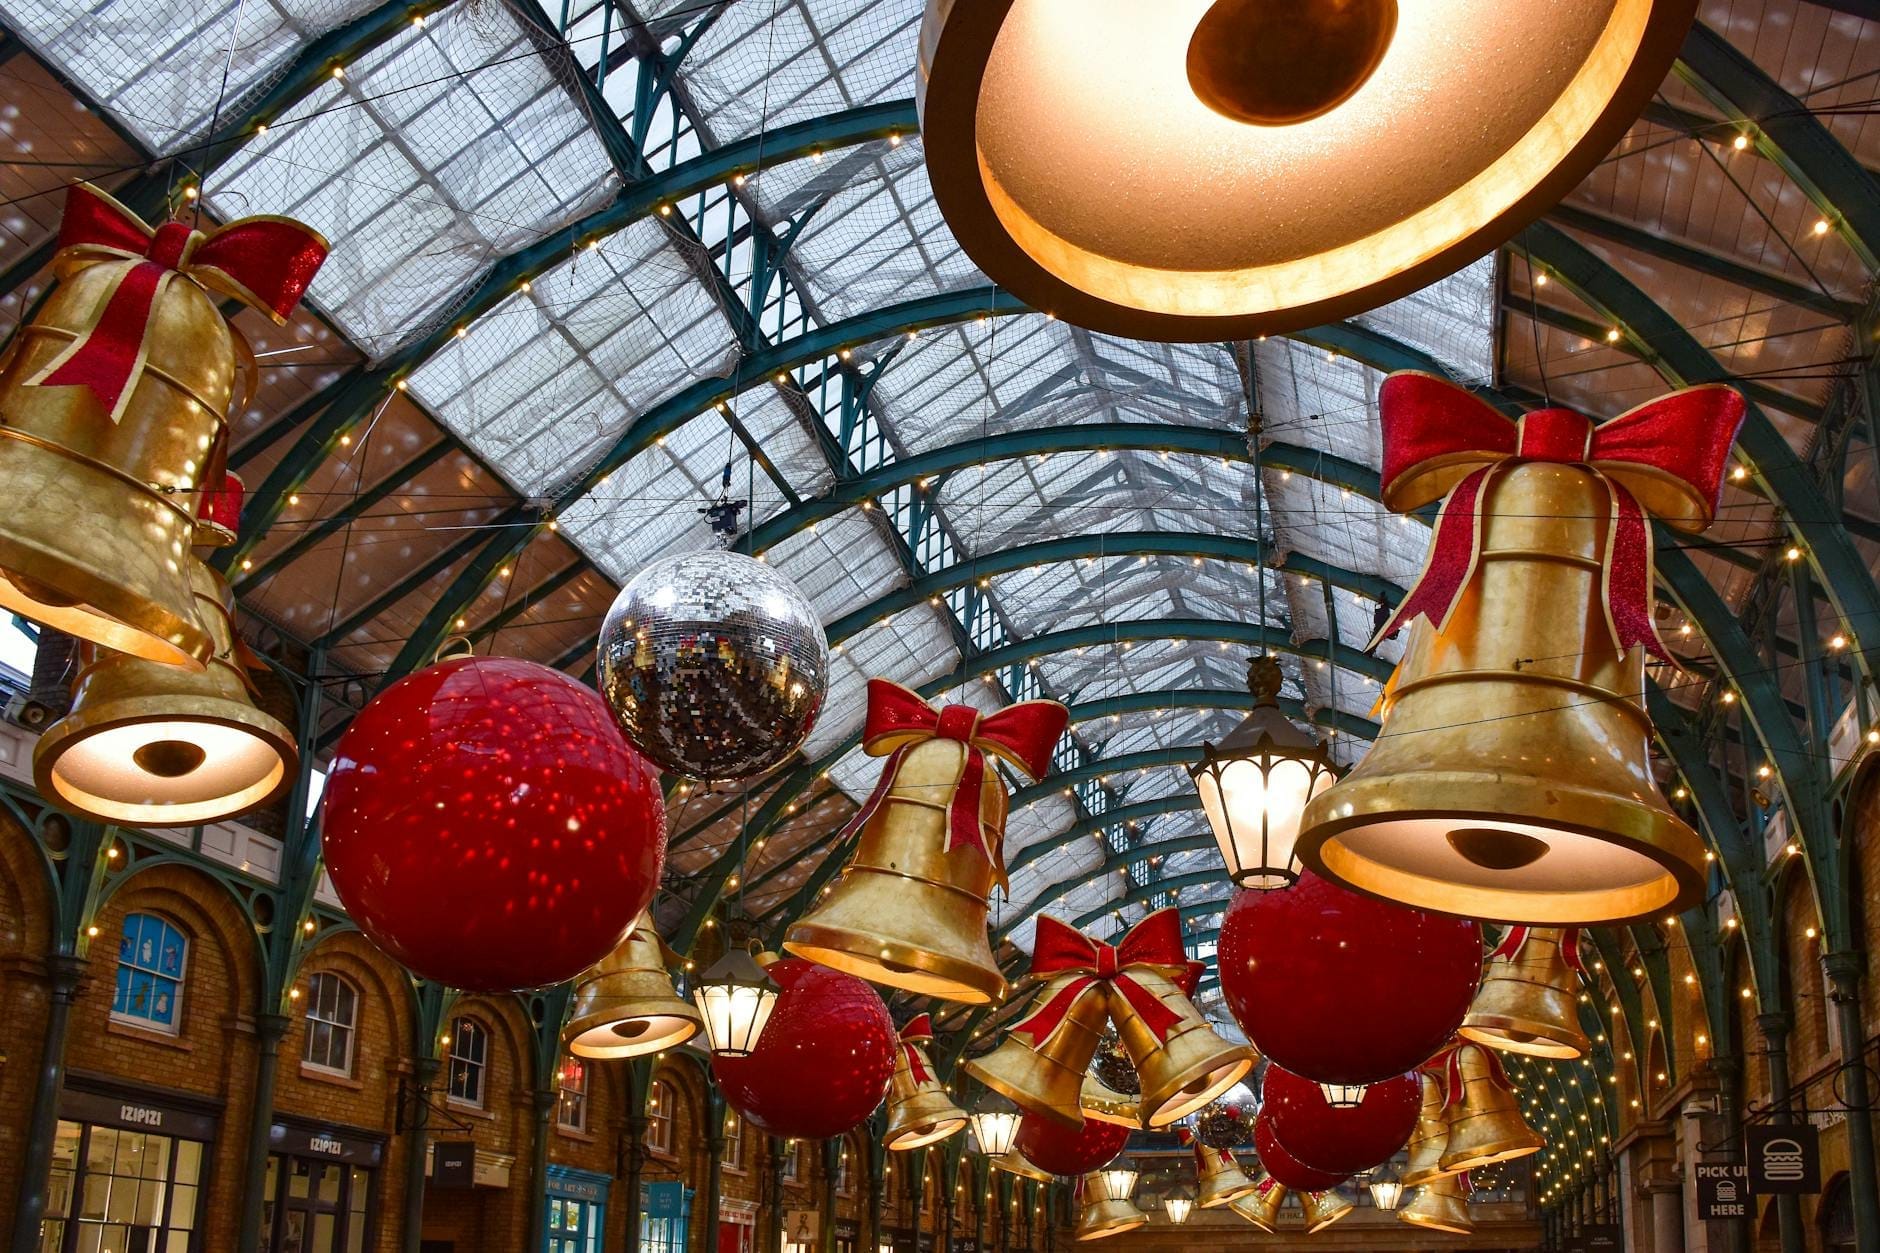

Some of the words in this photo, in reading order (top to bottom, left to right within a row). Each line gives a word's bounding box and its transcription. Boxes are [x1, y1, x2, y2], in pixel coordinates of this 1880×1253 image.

[120, 1104, 161, 1126] IZIPIZI
[310, 1138, 341, 1155] IZIPIZI
[1697, 1166, 1730, 1178] PICK
[1710, 1204, 1745, 1216] HERE
